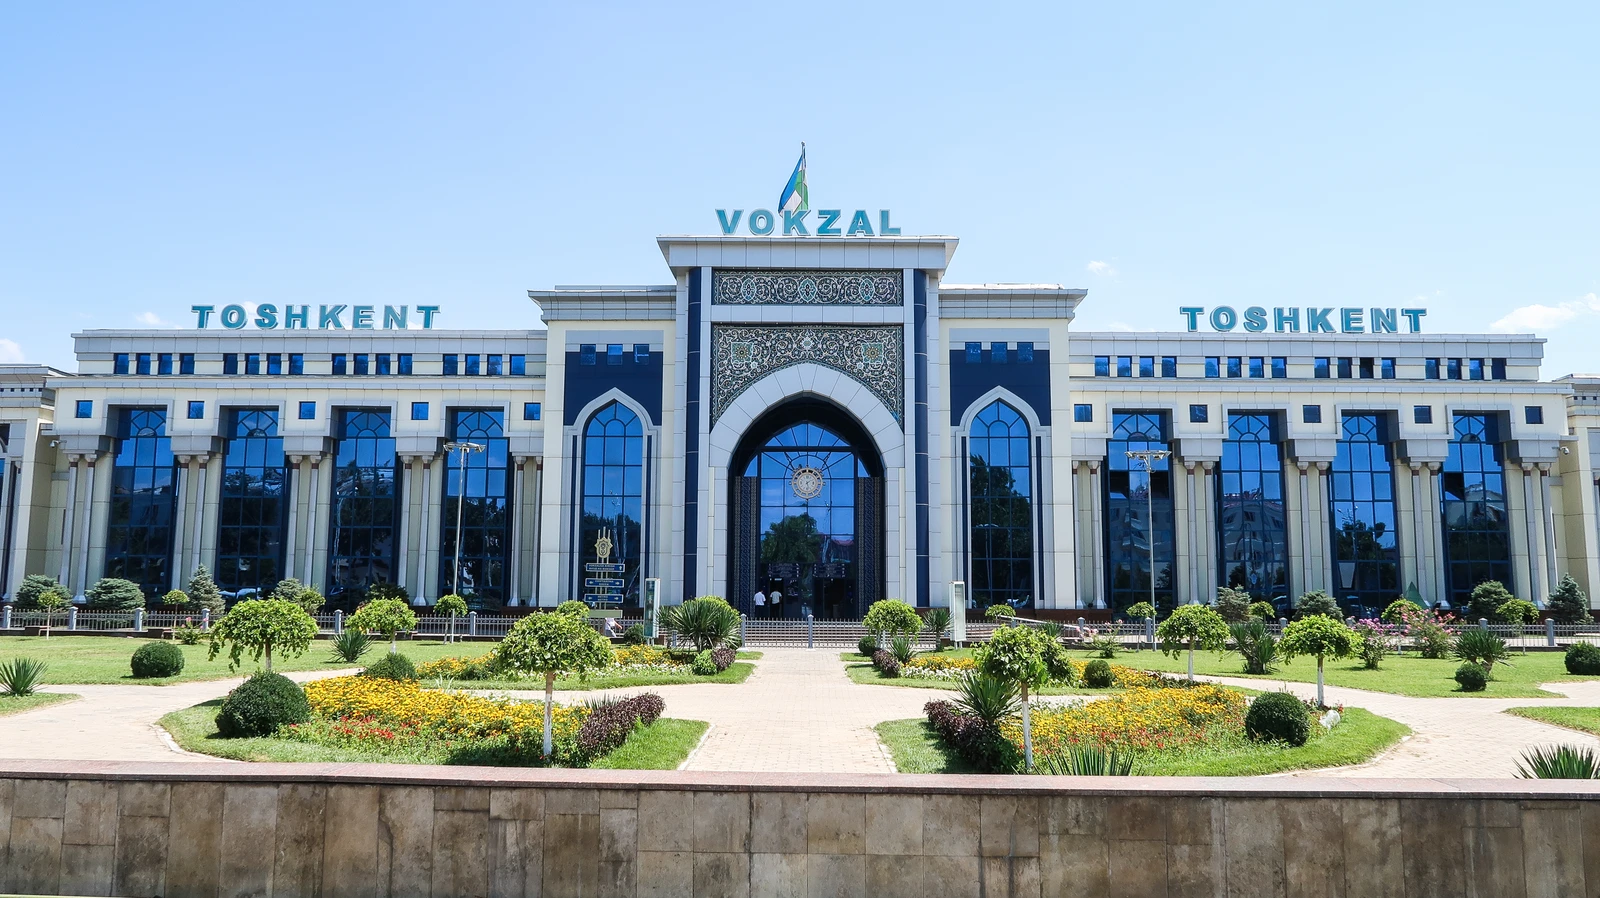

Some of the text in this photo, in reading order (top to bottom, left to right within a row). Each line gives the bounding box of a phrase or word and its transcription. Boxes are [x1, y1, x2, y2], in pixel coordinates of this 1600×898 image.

[715, 208, 901, 236] VOKZAL
[191, 303, 441, 330] TOSHKENT
[1179, 305, 1428, 333] TOSHKENT
